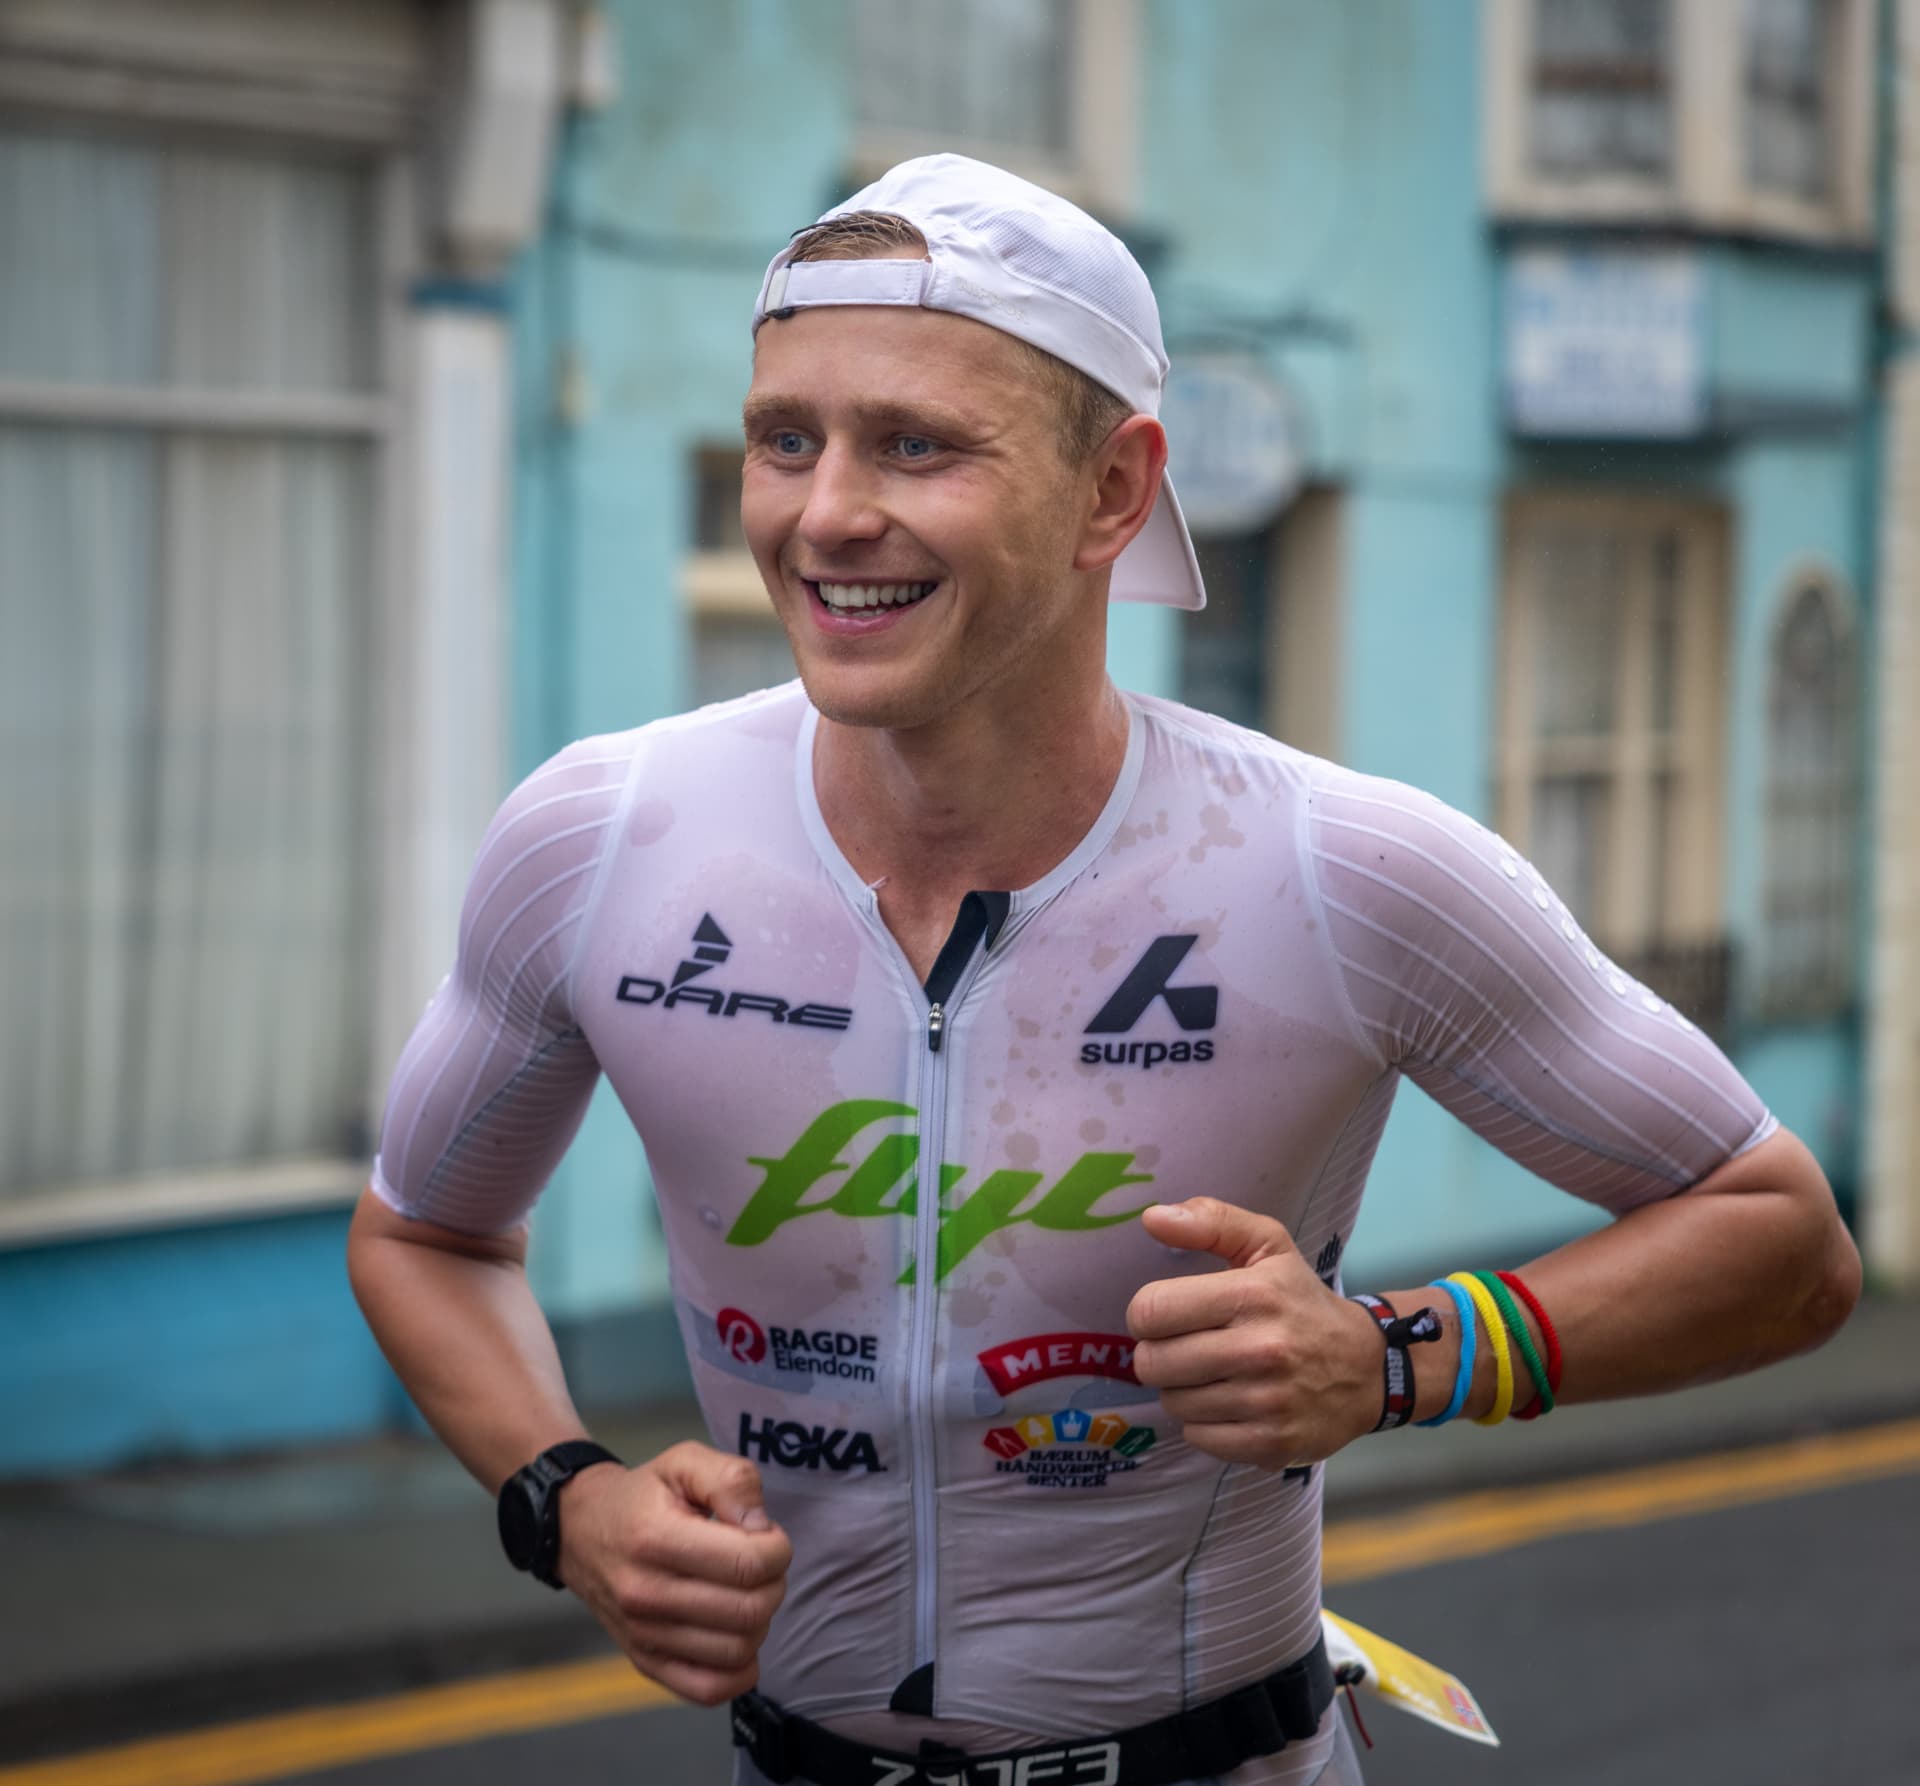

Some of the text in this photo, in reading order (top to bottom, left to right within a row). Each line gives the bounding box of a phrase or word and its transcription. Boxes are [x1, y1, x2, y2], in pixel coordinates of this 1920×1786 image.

[615, 975, 853, 1030] DARE
[1080, 1039, 1214, 1069] surpas
[725, 1099, 1157, 1285] flyt
[770, 1327, 877, 1360] RAGDE
[773, 1351, 875, 1383] Eiendom
[739, 1412, 882, 1473] HOKA
